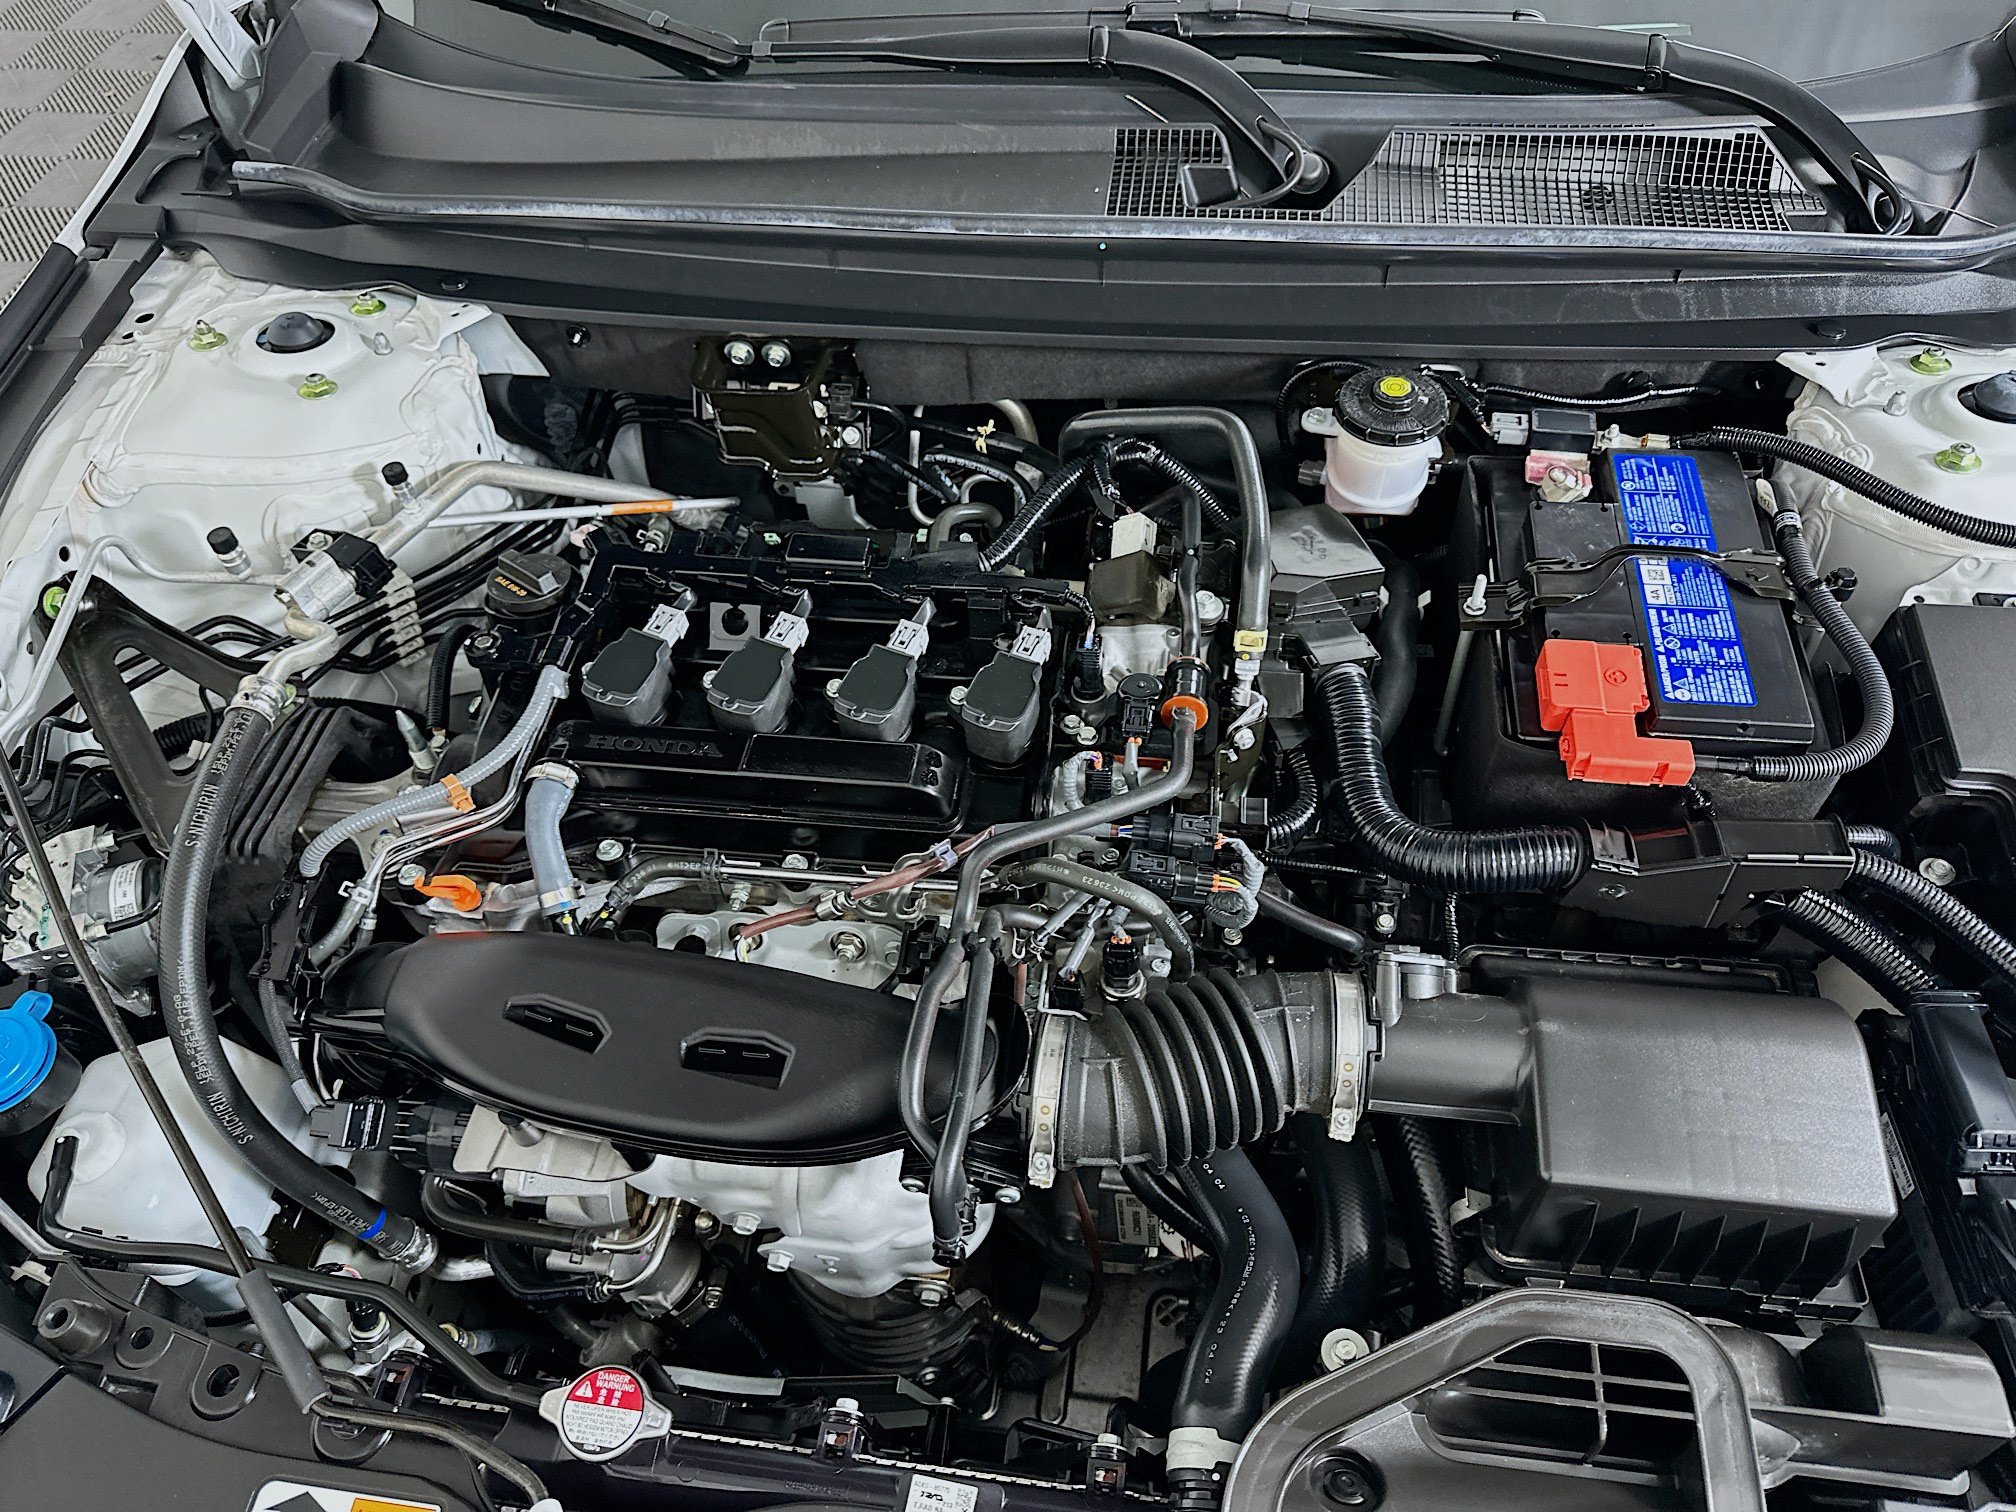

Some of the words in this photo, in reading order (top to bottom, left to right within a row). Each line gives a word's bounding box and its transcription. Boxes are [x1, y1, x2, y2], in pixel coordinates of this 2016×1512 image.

[495, 577, 510, 586] SAE
[1649, 589, 1660, 599] 4A
[584, 734, 724, 757] HONDA
[1082, 875, 1093, 883] 23
[1094, 880, 1111, 891] 236
[598, 1371, 630, 1382] DANGER
[595, 1380, 635, 1392] WARNUNG
